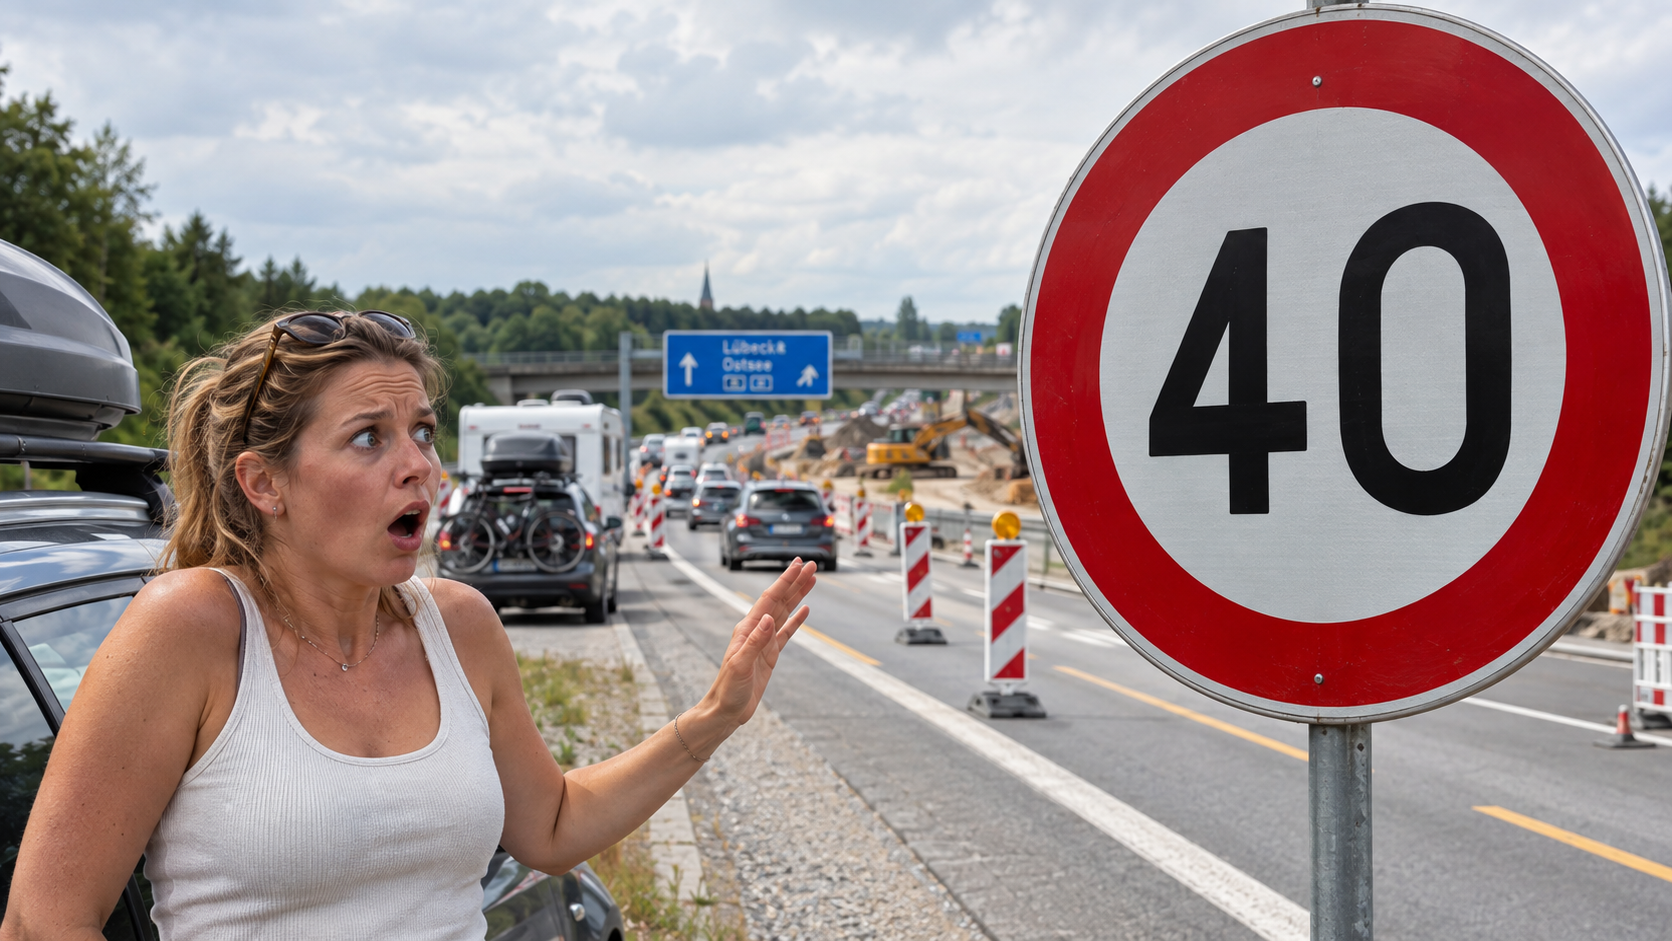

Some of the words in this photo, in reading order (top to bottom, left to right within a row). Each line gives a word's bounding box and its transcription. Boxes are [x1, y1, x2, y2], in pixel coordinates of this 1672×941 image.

[722, 339, 775, 355] Lübeck
[722, 356, 773, 372] Ostsee
[1149, 202, 1511, 515] 40
